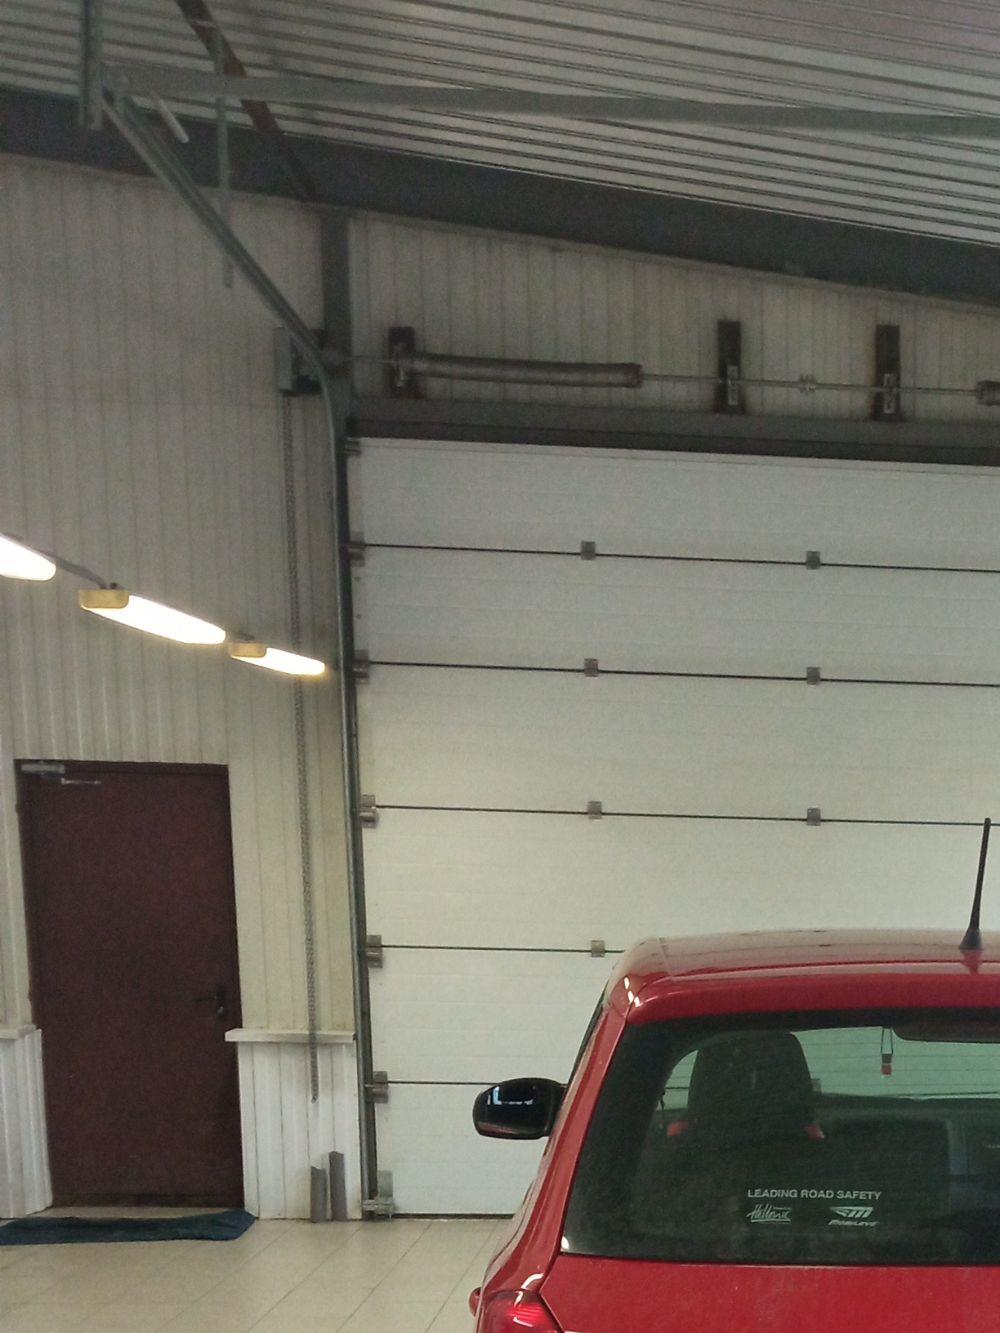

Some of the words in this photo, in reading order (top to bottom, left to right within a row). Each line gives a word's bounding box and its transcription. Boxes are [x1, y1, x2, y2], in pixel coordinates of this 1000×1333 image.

[747, 1188, 798, 1198] LEADING
[801, 1189, 835, 1199] ROAD
[836, 1190, 881, 1200] SAFETY
